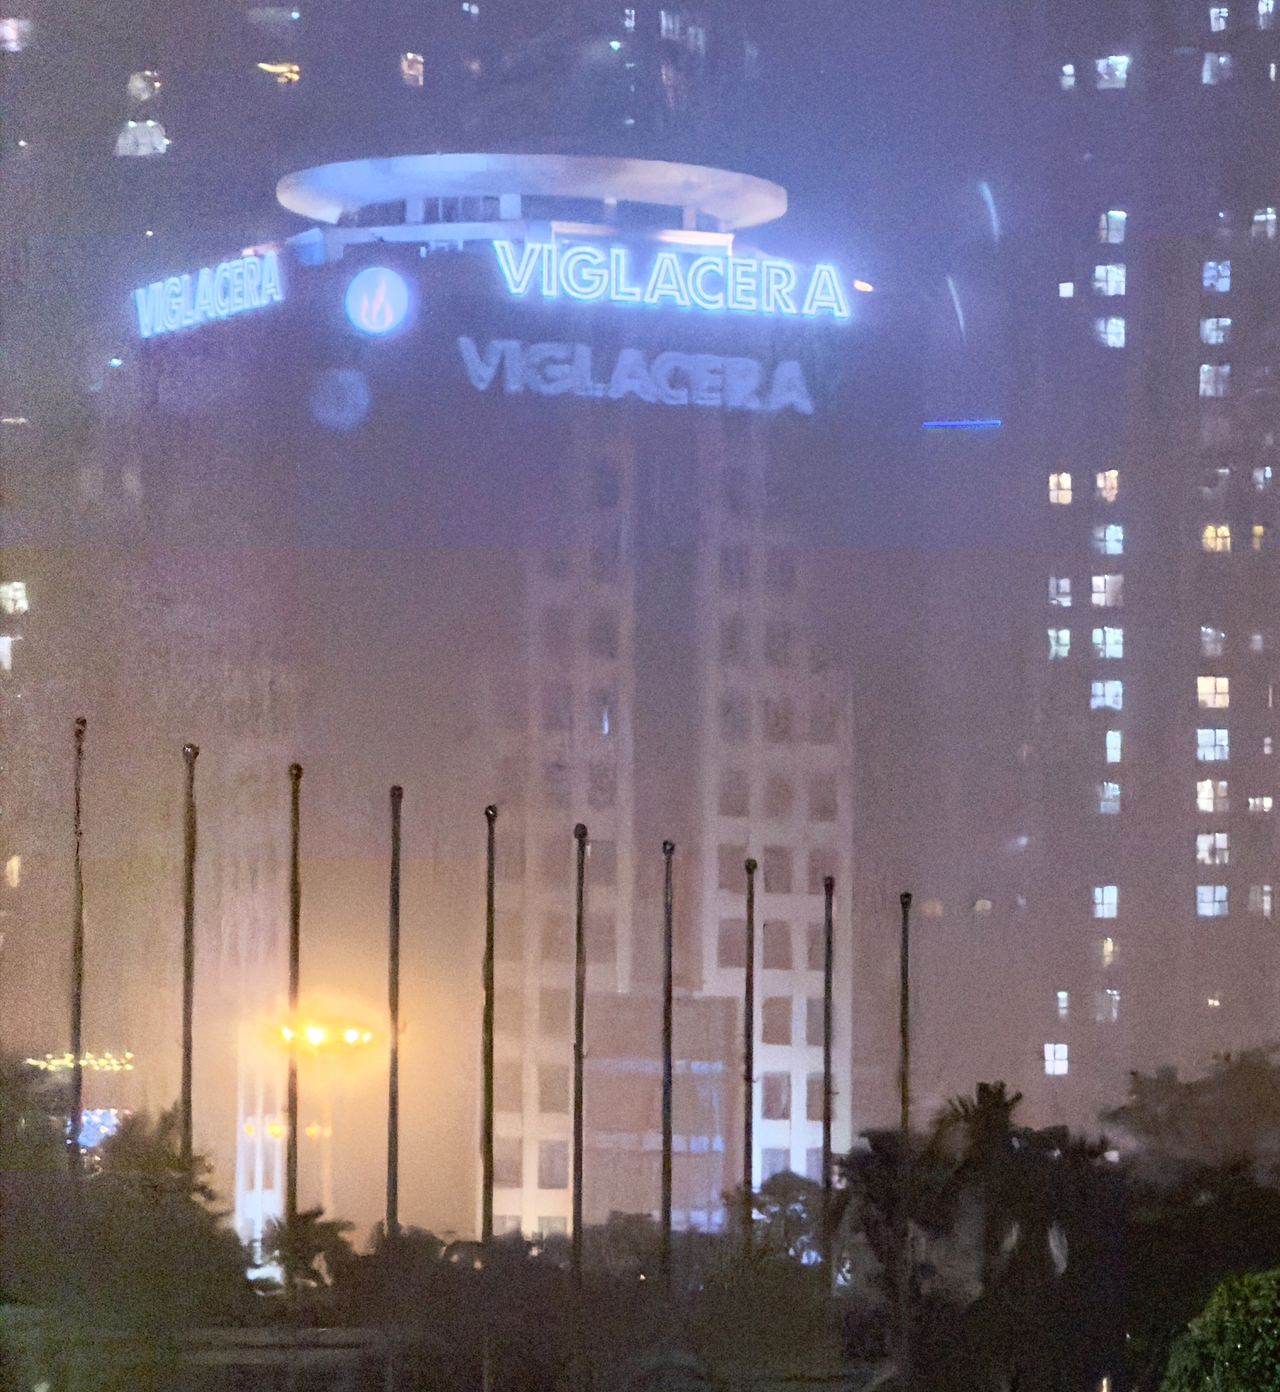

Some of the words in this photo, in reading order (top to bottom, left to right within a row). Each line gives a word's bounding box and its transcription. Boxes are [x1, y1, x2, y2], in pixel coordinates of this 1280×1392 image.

[134, 250, 283, 338] VIGLACERA
[493, 240, 849, 318] VIGLACERA
[457, 335, 815, 415] VIGLACERA
